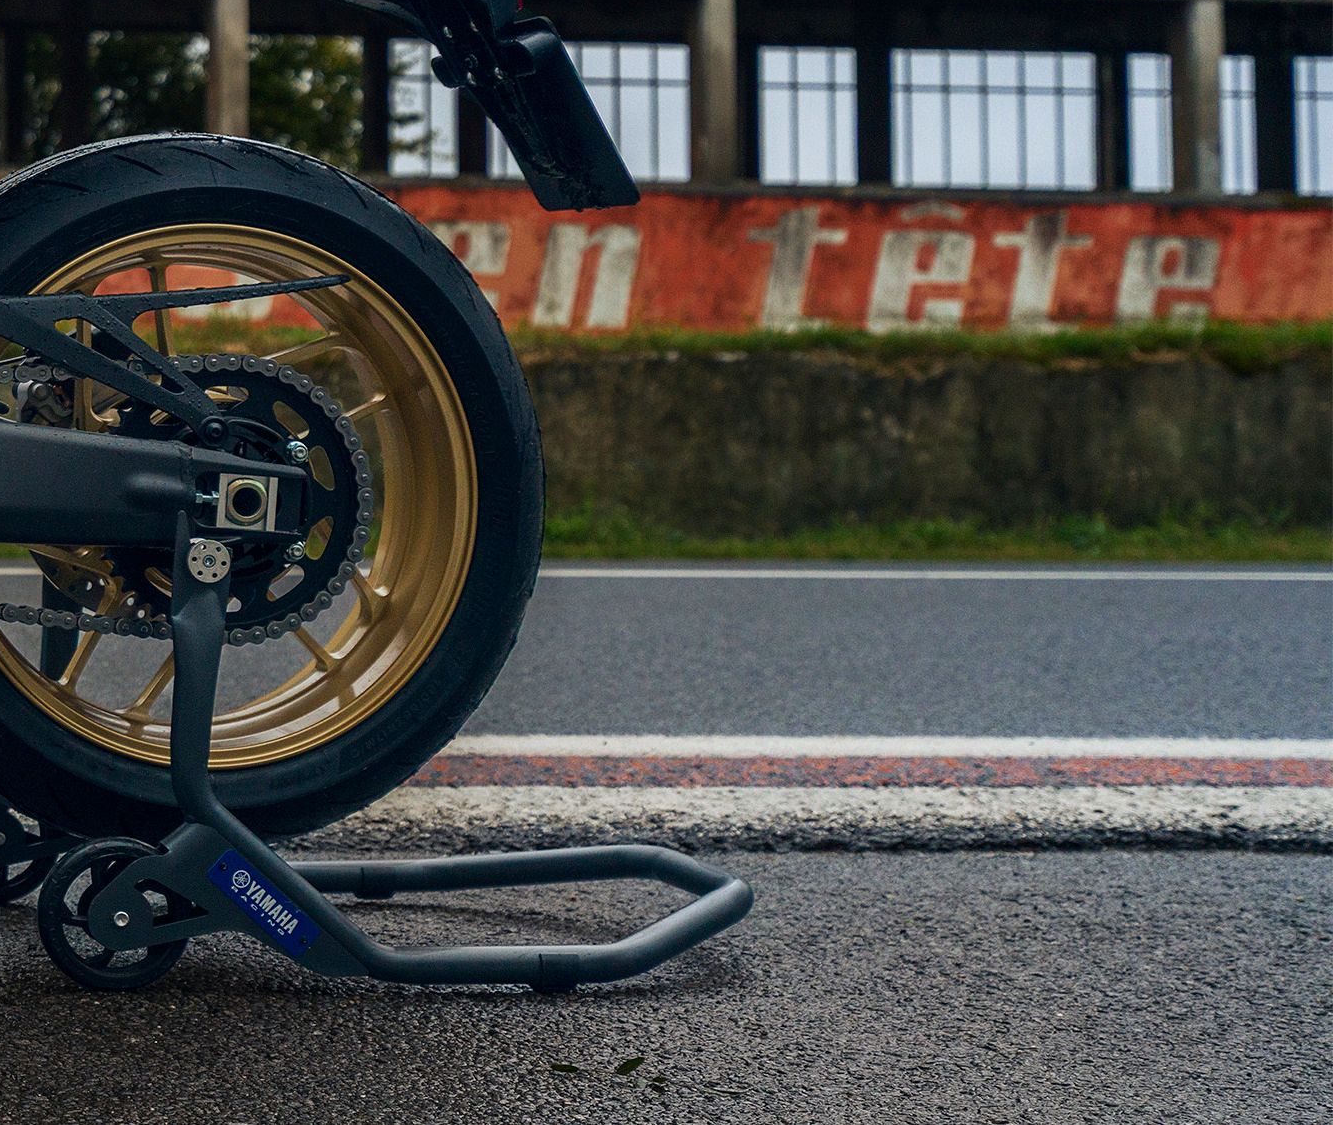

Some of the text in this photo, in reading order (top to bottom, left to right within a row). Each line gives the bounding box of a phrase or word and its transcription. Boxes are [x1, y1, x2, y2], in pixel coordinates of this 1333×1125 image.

[745, 201, 1223, 335] tête
[230, 885, 287, 937] RACING
[246, 879, 300, 935] YAMAHA
